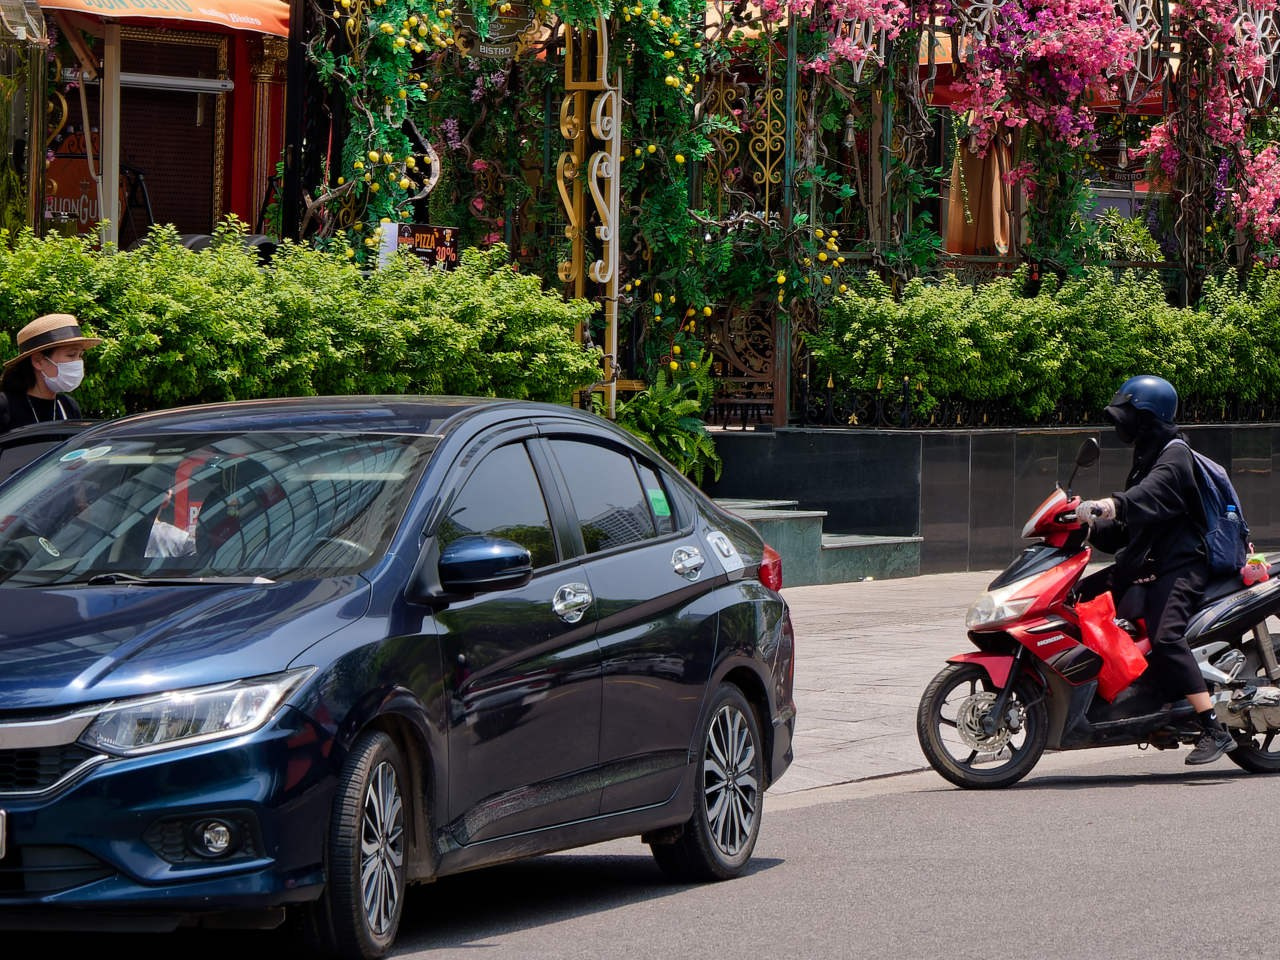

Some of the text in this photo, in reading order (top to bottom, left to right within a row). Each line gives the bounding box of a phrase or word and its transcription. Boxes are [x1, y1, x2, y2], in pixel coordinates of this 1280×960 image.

[480, 45, 511, 56] BISTRO
[415, 233, 436, 249] PIZZA
[436, 246, 456, 262] 30%
[1037, 634, 1065, 647] HONDA
